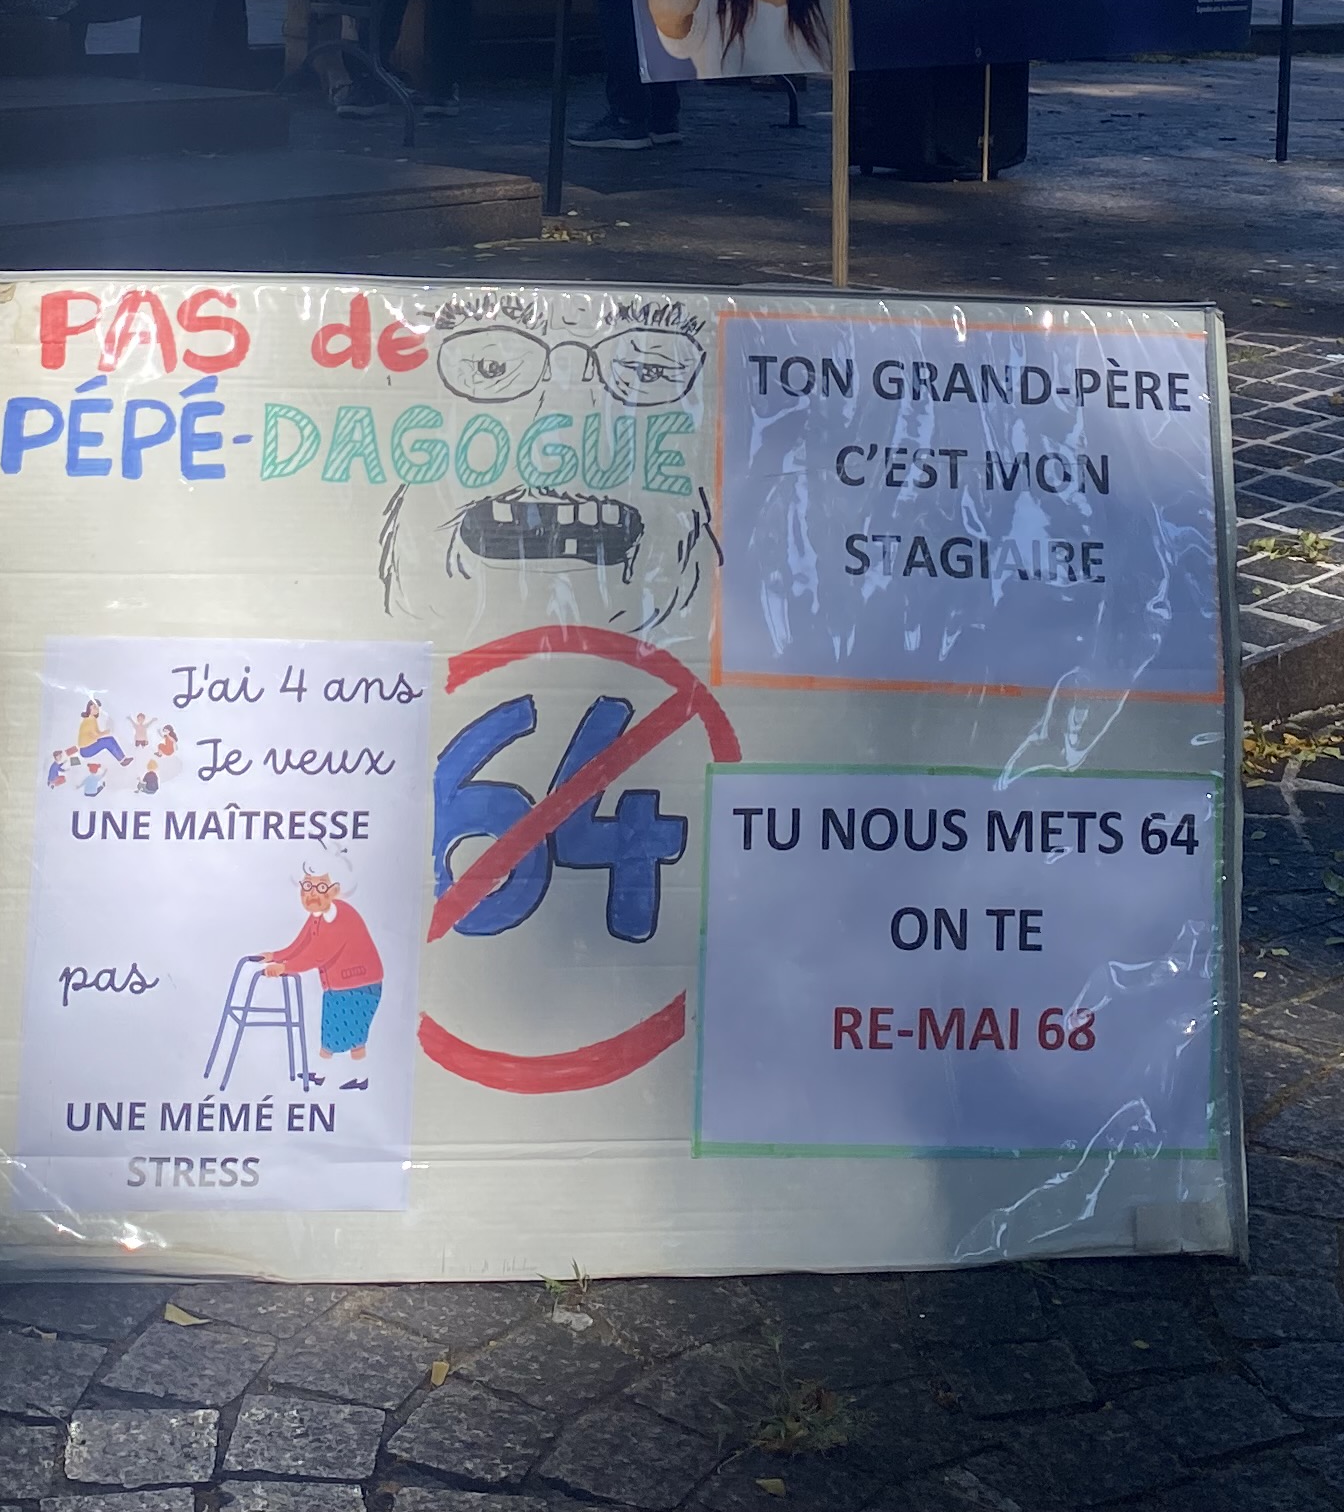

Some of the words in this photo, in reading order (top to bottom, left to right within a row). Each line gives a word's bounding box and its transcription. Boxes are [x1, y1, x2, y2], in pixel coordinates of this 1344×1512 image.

[38, 289, 250, 374] PAS
[311, 291, 429, 372] de
[749, 354, 854, 399] TON
[872, 358, 1191, 412] GRAND-PÈRE
[1, 374, 694, 495] PÉPÉ-DAGOGUE
[836, 443, 968, 490] C'EST
[985, 451, 1110, 496] MON
[844, 533, 1106, 584] STAGIAIRE
[171, 664, 265, 708] J'ai
[279, 664, 307, 702] 4
[323, 670, 424, 705] ans
[196, 736, 253, 781] Je
[263, 744, 397, 778] veux
[71, 810, 150, 841] UNE
[164, 800, 370, 841] MAÎTRESSE
[432, 694, 688, 944] 64
[732, 807, 800, 851] TU
[821, 807, 968, 852] NOUS
[986, 809, 1124, 855] METS
[1140, 812, 1200, 856] 64
[890, 906, 968, 952] ON
[986, 908, 1044, 952] TE
[59, 963, 160, 1006] pas
[832, 1006, 1019, 1051] RE-MAI
[1037, 1007, 1096, 1052] 68
[66, 1102, 146, 1132] UNE
[159, 1094, 275, 1133] MÉMÉ
[287, 1102, 336, 1133] EN
[126, 1155, 261, 1189] STRESS
